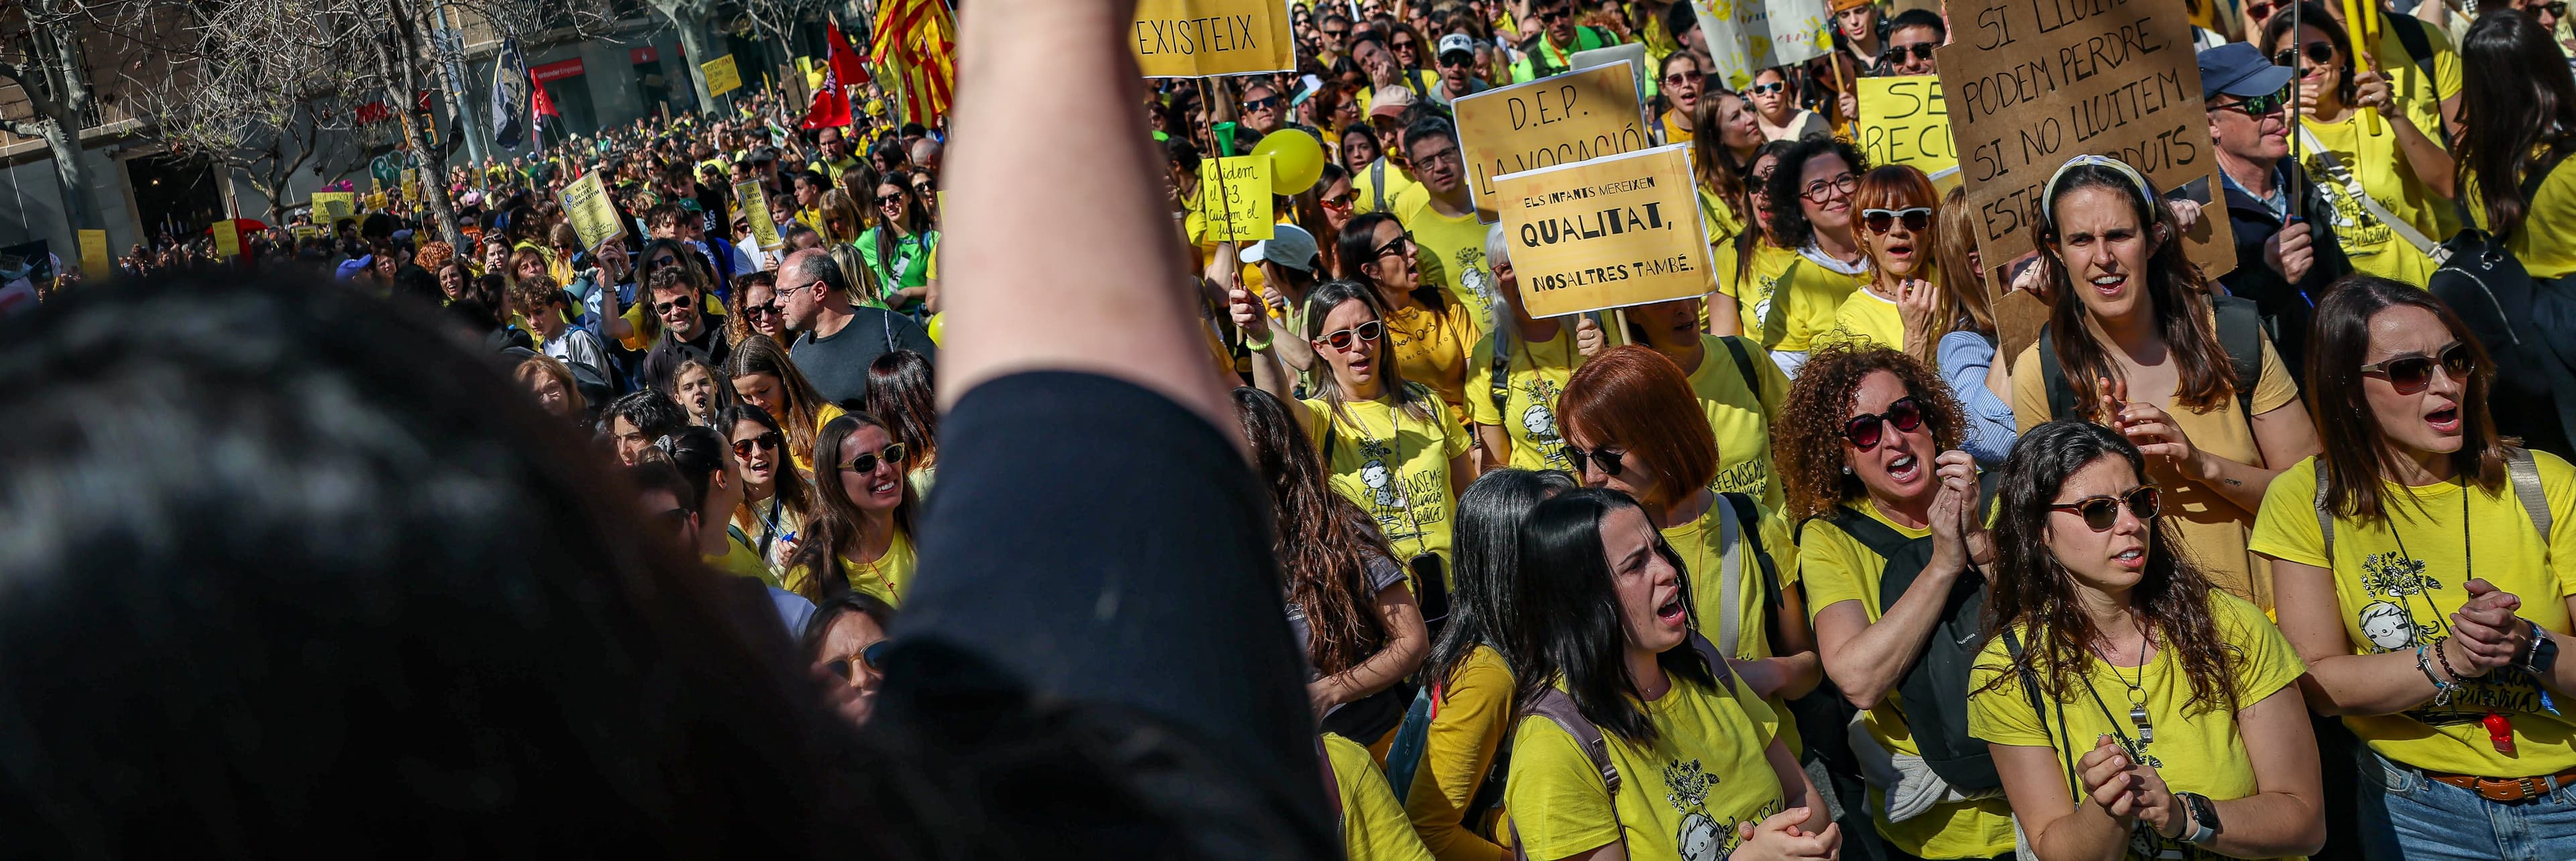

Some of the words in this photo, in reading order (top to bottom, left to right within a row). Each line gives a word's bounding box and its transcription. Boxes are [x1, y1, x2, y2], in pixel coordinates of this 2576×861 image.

[1136, 13, 1256, 55] EXISTEIX
[1976, 5, 2016, 52] SI
[537, 70, 559, 80] antander
[1962, 56, 2056, 124] PODEM
[1507, 84, 1589, 131] D.E.P.
[1974, 137, 2009, 182] SI
[2020, 117, 2061, 166] NO
[2070, 67, 2186, 144] LLUITEM
[1477, 158, 1508, 196] LA
[1516, 122, 1642, 172] VOCACIÓ
[1866, 123, 1958, 166] RECU
[572, 190, 600, 209] COMPARTIM
[574, 186, 593, 200] DECRET
[1208, 209, 1243, 222] Cuim
[1247, 200, 1259, 219] el
[1210, 184, 1218, 202] el
[1523, 195, 1546, 209] ELS
[1548, 186, 1596, 205] INFANTS
[1598, 176, 1656, 196] MEREIXEN
[1982, 179, 2047, 242] ESTE
[1520, 201, 1672, 248] QUALITAT,
[1532, 264, 1629, 293] NOSALTRES
[1632, 253, 1695, 278] TAMBÉ.
